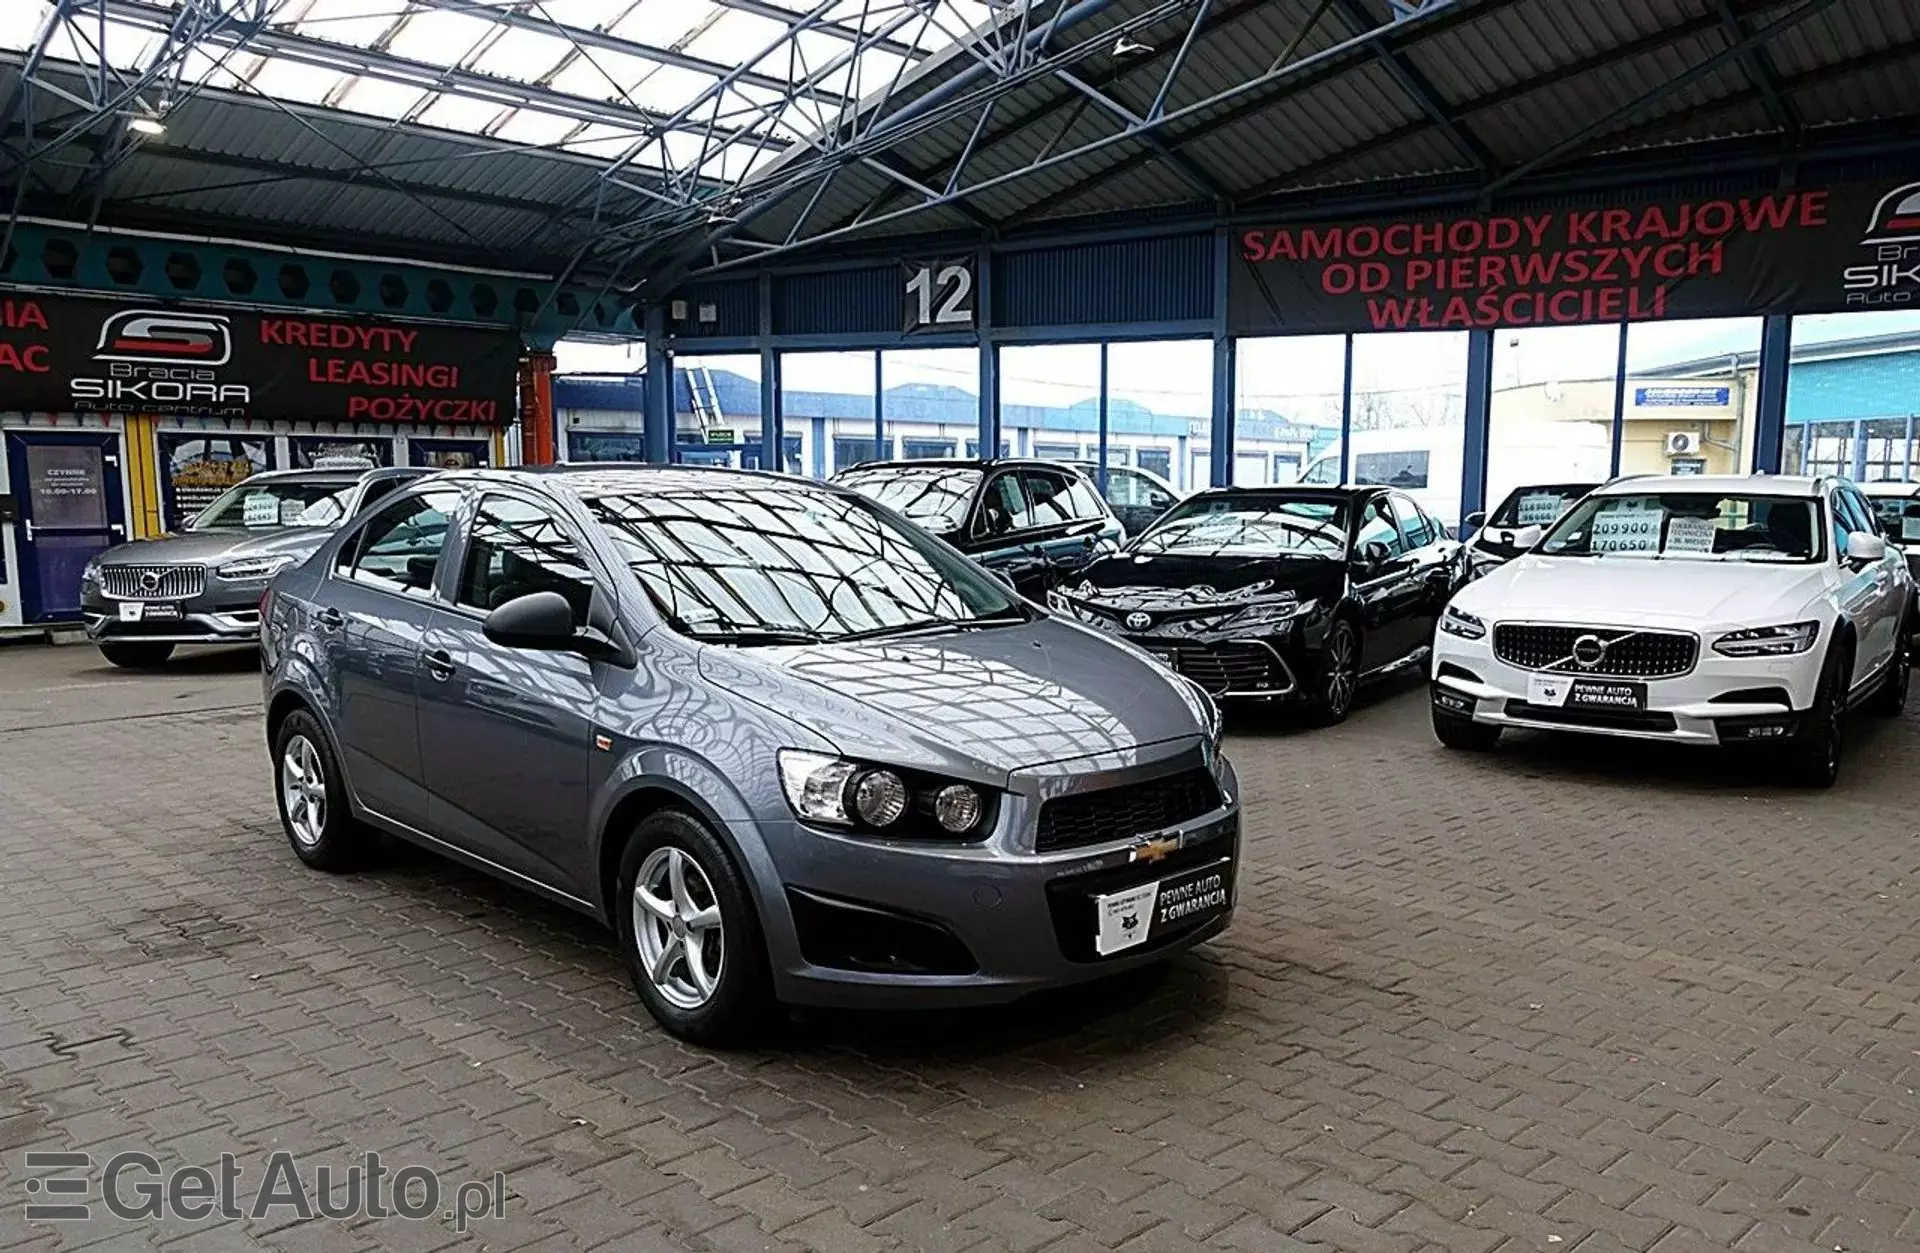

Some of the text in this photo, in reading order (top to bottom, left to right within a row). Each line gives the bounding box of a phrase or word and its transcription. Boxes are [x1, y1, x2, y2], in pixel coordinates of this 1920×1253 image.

[1243, 191, 1830, 261] SAMOCHODY KRAJOWE
[1321, 240, 1723, 294] OD PIERWSZYCH
[905, 265, 972, 324] 12
[1367, 284, 1667, 329] WŁAŚCICIELI
[1846, 291, 1911, 305] Auto
[0, 300, 49, 330] IA
[260, 319, 418, 352] KREDYTY
[110, 362, 215, 381] Bracia
[308, 357, 460, 388] LEASINGI
[70, 378, 250, 403] SIKORA
[74, 400, 245, 416] Auto centrum
[348, 392, 497, 421] POŻYCZKI
[1574, 683, 1632, 696] PEWNE AUTO
[1160, 883, 1194, 906] PEWNE
[1195, 874, 1220, 895] AUTO
[1160, 908, 1167, 923] Z
